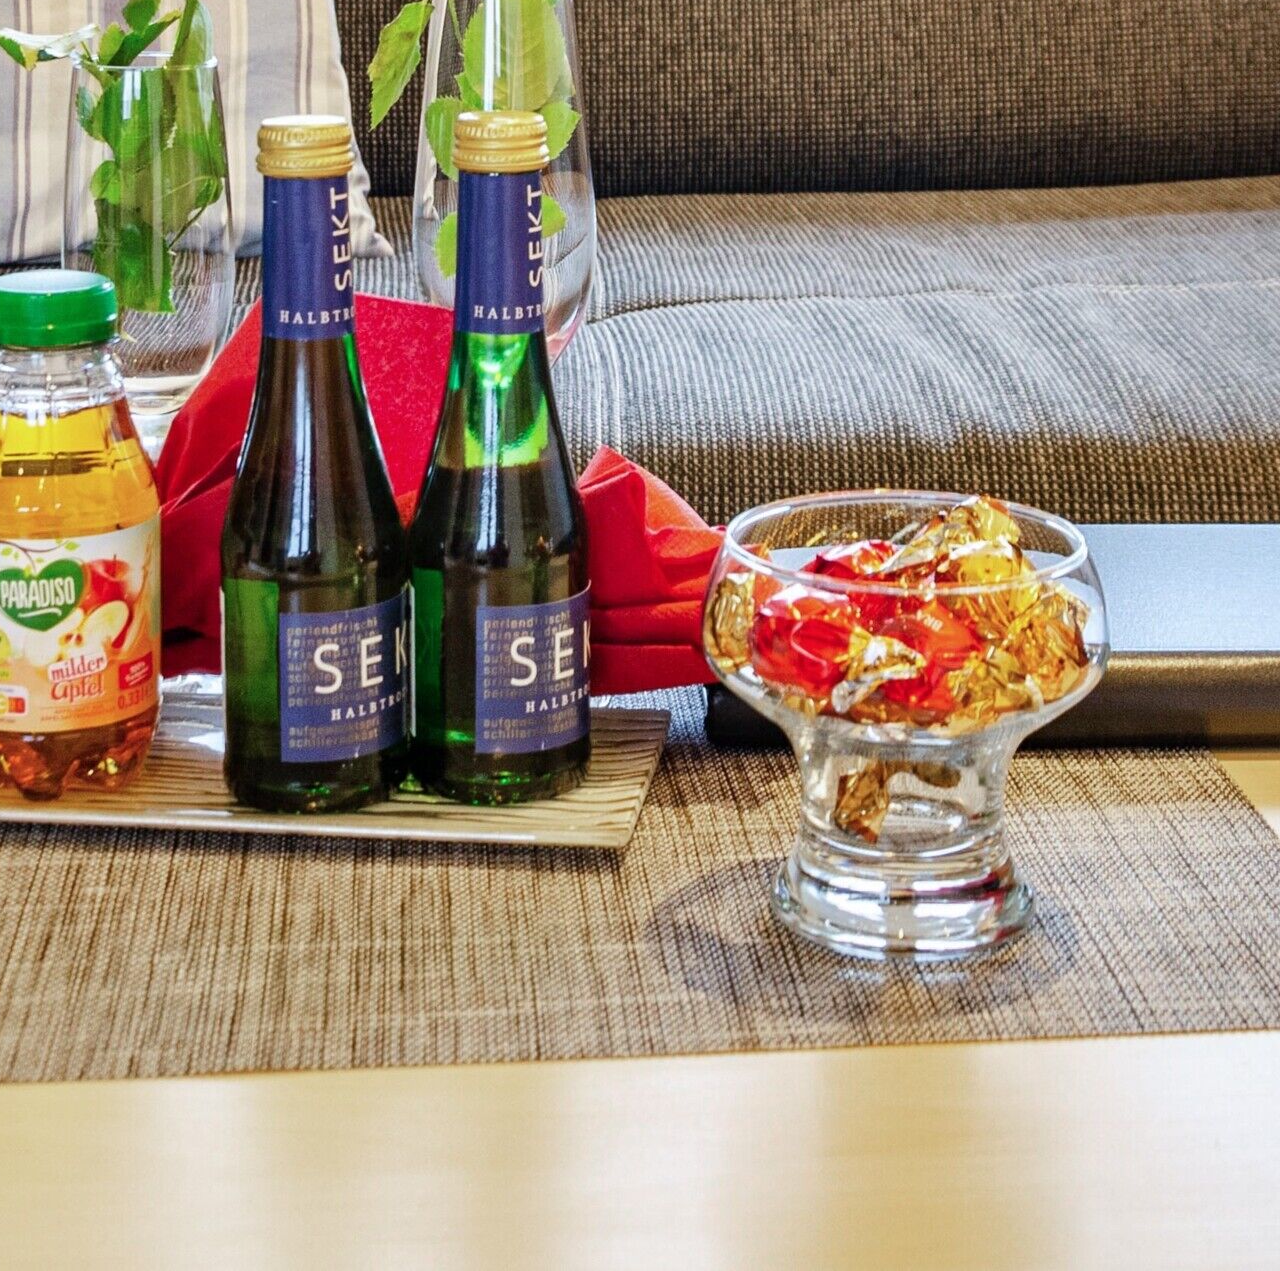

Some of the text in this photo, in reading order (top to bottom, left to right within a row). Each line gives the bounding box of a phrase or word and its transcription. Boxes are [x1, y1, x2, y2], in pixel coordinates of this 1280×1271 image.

[329, 187, 353, 291] SEKT
[526, 184, 544, 288] SEKT
[0, 576, 76, 609] PARADISO
[51, 654, 104, 680] milder
[314, 620, 408, 695] SEK
